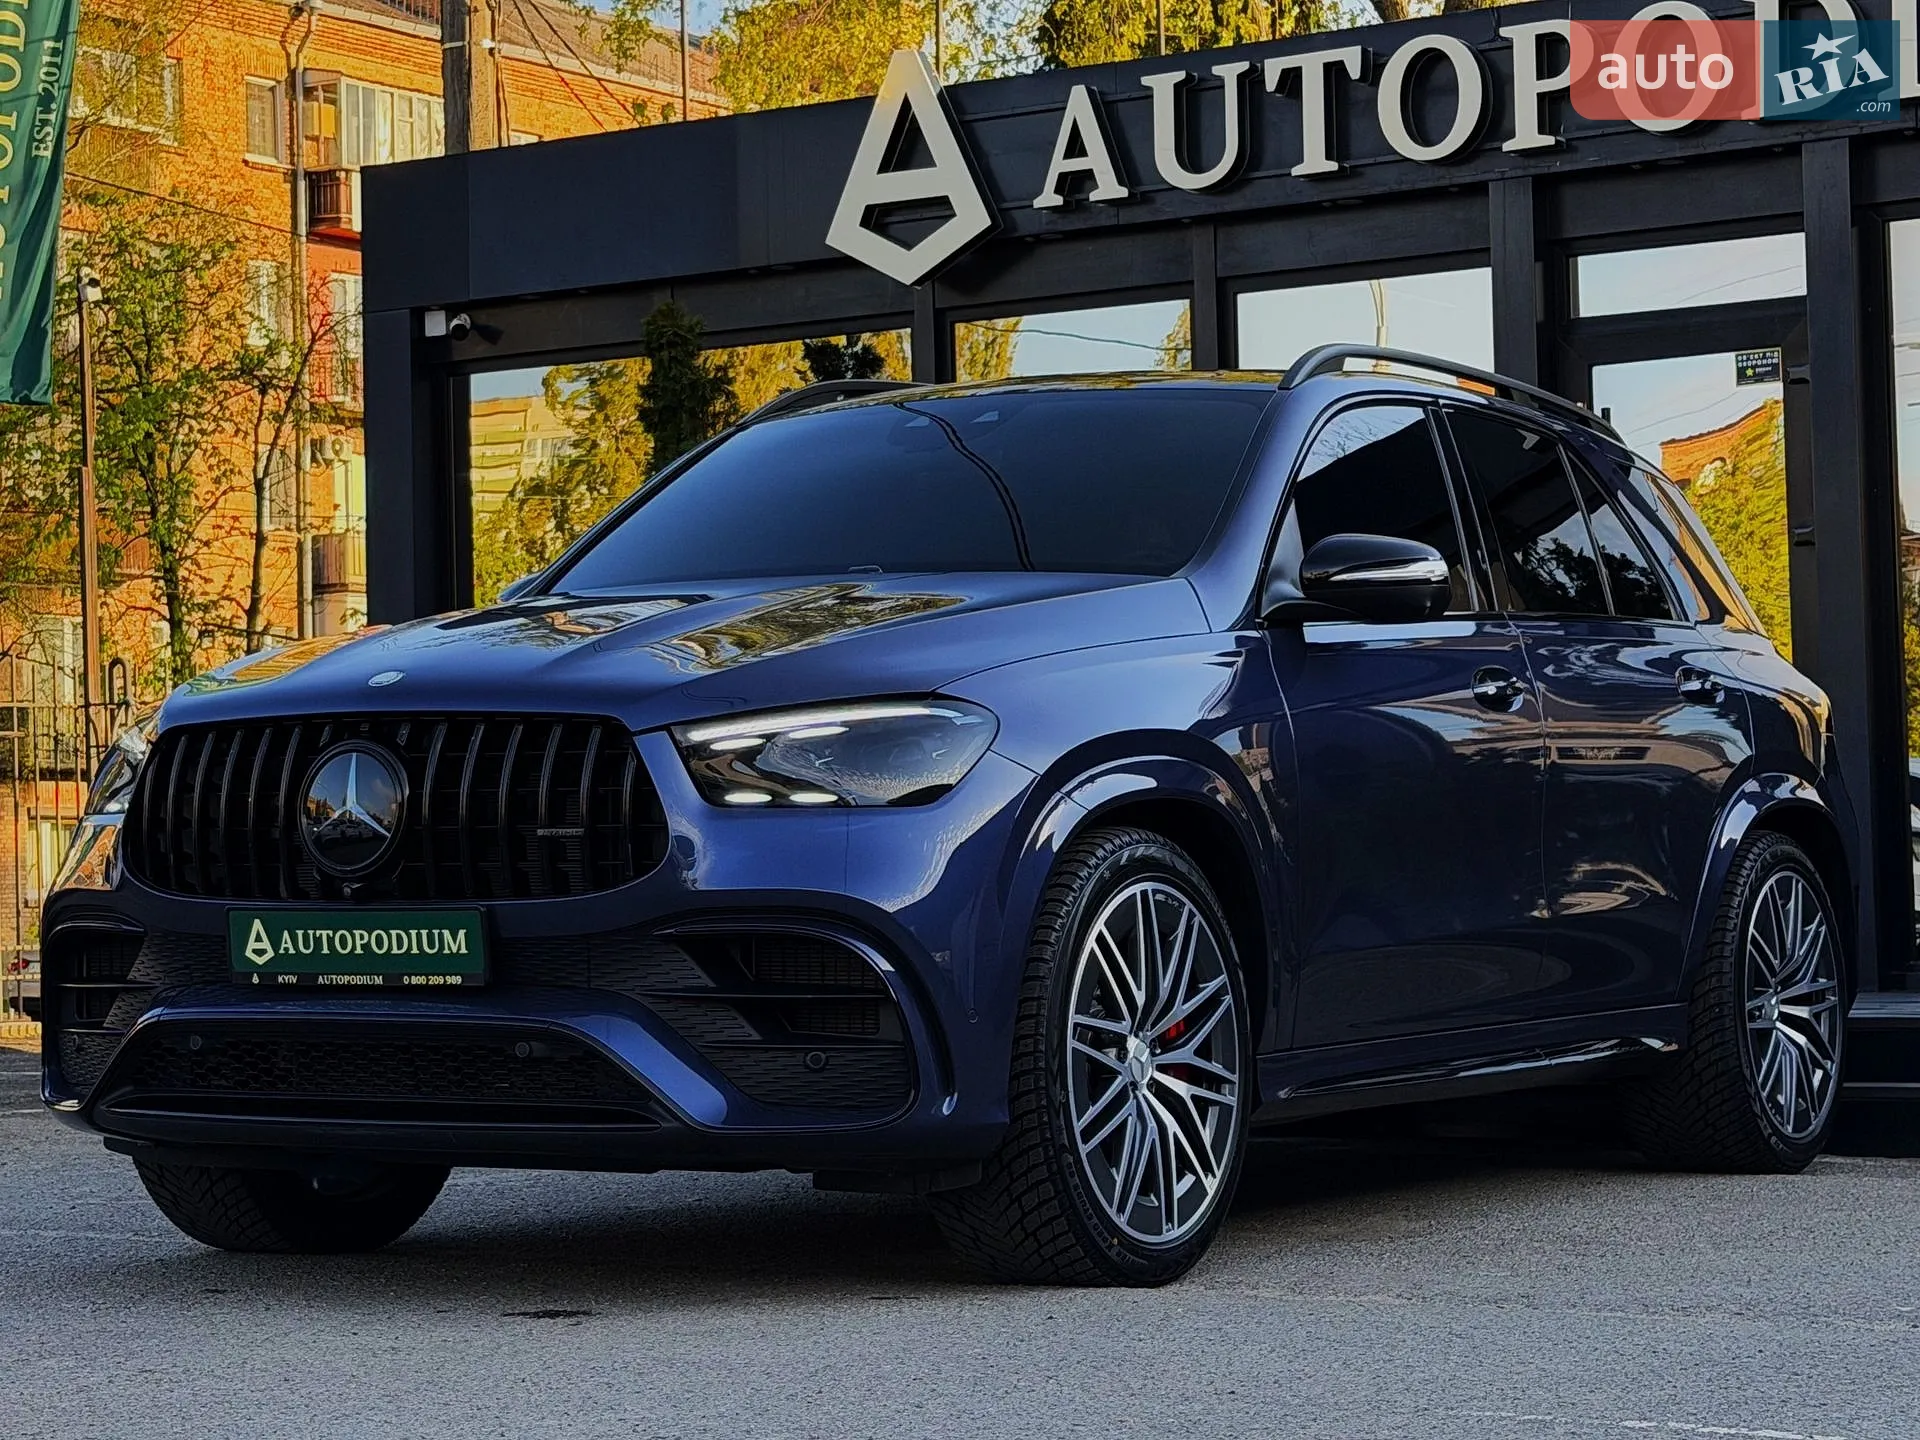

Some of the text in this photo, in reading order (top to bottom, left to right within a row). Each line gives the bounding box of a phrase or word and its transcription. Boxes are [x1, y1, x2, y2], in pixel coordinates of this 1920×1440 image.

[32, 39, 64, 158] EST. 2011
[278, 929, 469, 955] AUTOPODIUM
[277, 974, 298, 984] KYIV
[317, 974, 384, 985] AUTOPODIUM
[410, 975, 427, 985] 800
[428, 975, 444, 985] 209
[445, 975, 462, 985] 989
